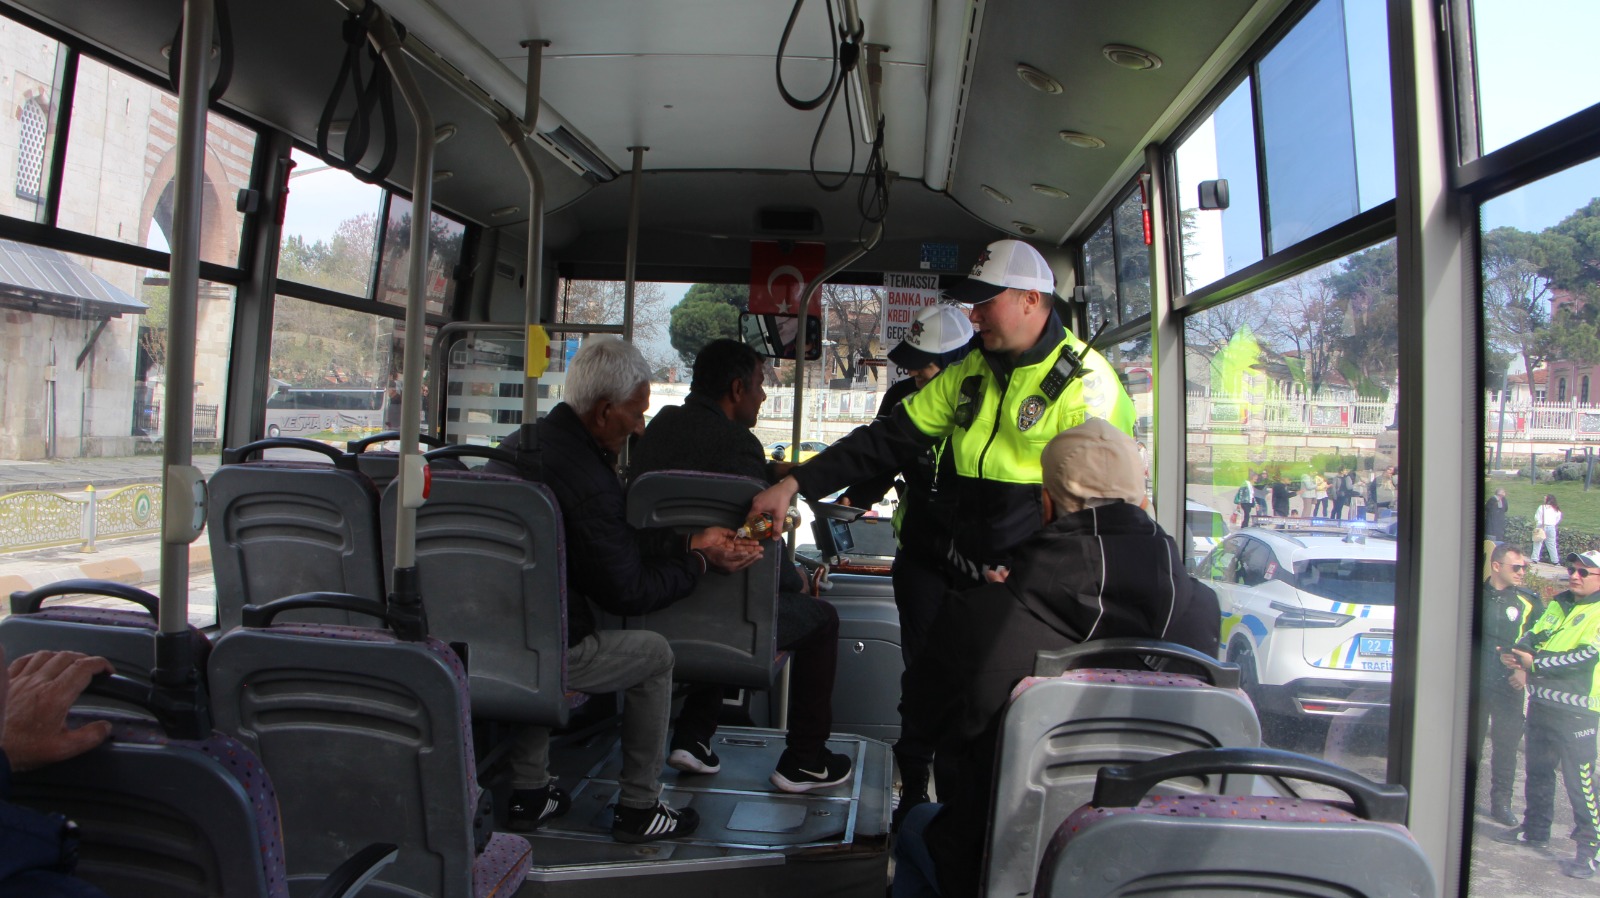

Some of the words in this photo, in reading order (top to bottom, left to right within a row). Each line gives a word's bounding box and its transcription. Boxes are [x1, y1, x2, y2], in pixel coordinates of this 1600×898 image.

[890, 274, 937, 290] TEMASSIZ
[888, 291, 921, 306] BANKA
[924, 296, 936, 306] ve
[888, 307, 911, 323] KREDİ
[887, 325, 909, 342] GEÇE
[1367, 640, 1381, 651] 22
